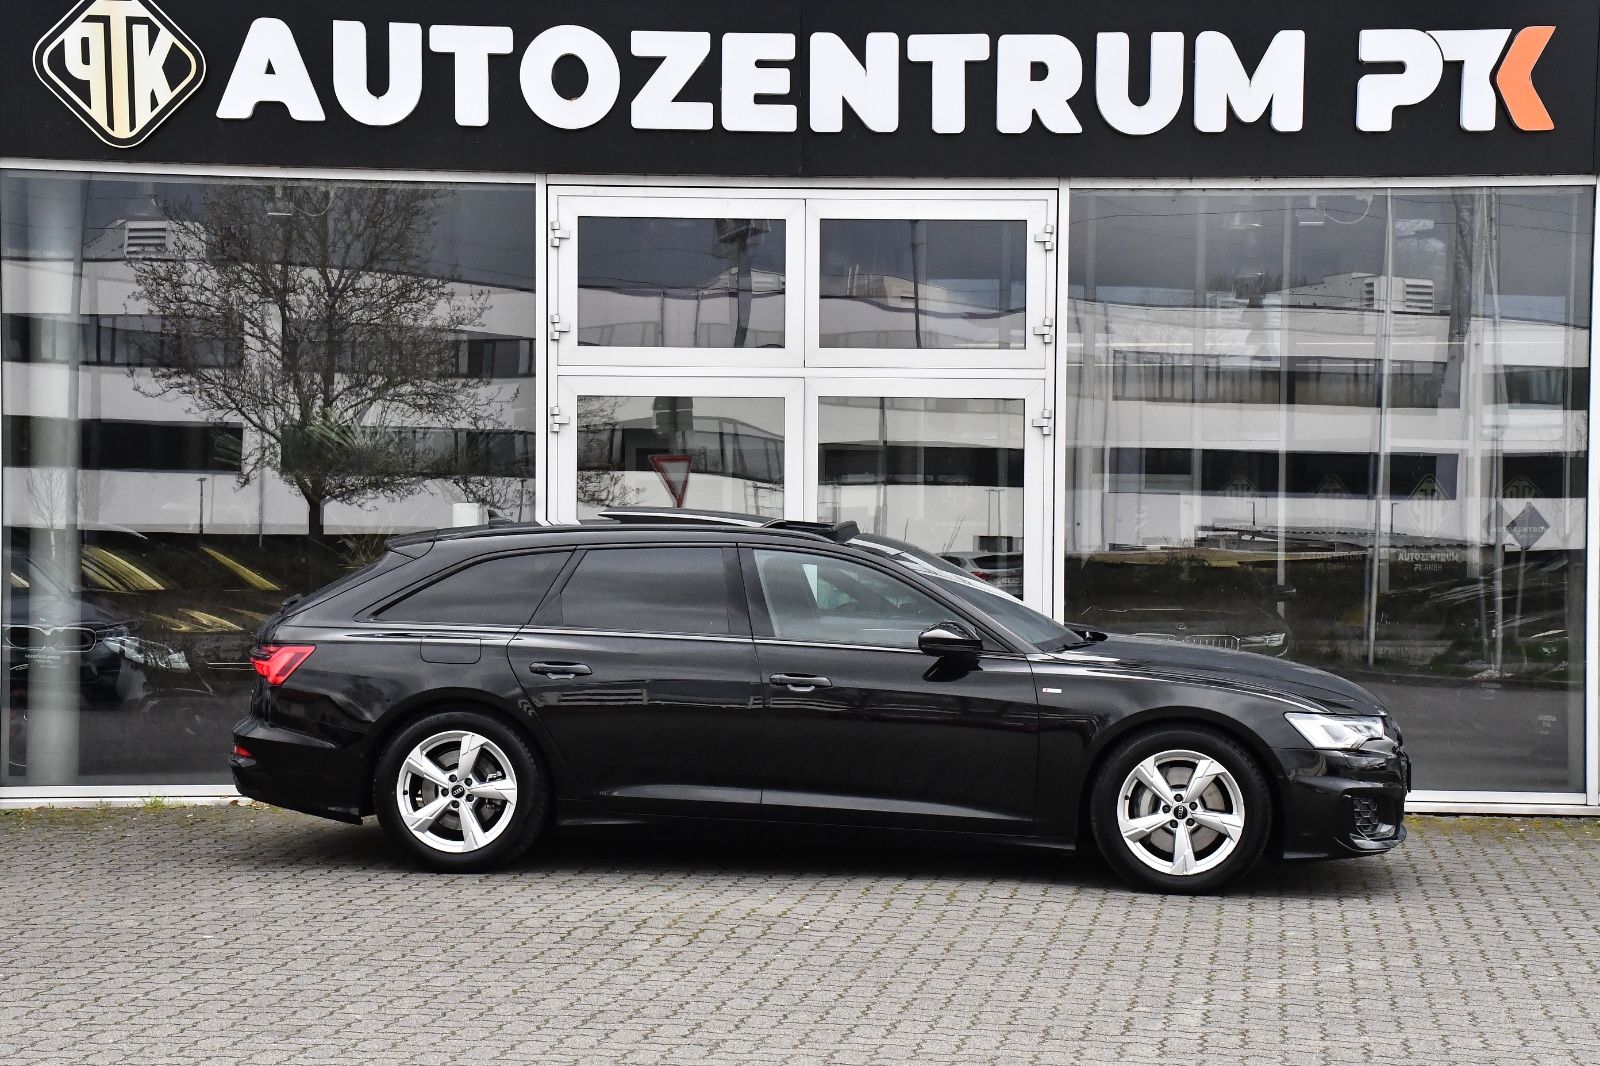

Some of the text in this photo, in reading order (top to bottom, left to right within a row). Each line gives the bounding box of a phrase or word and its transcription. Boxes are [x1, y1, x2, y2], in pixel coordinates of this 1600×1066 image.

[216, 17, 1556, 136] AUTOZENTRUM PTK
[1398, 552, 1459, 562] AUTOZENTRUM
